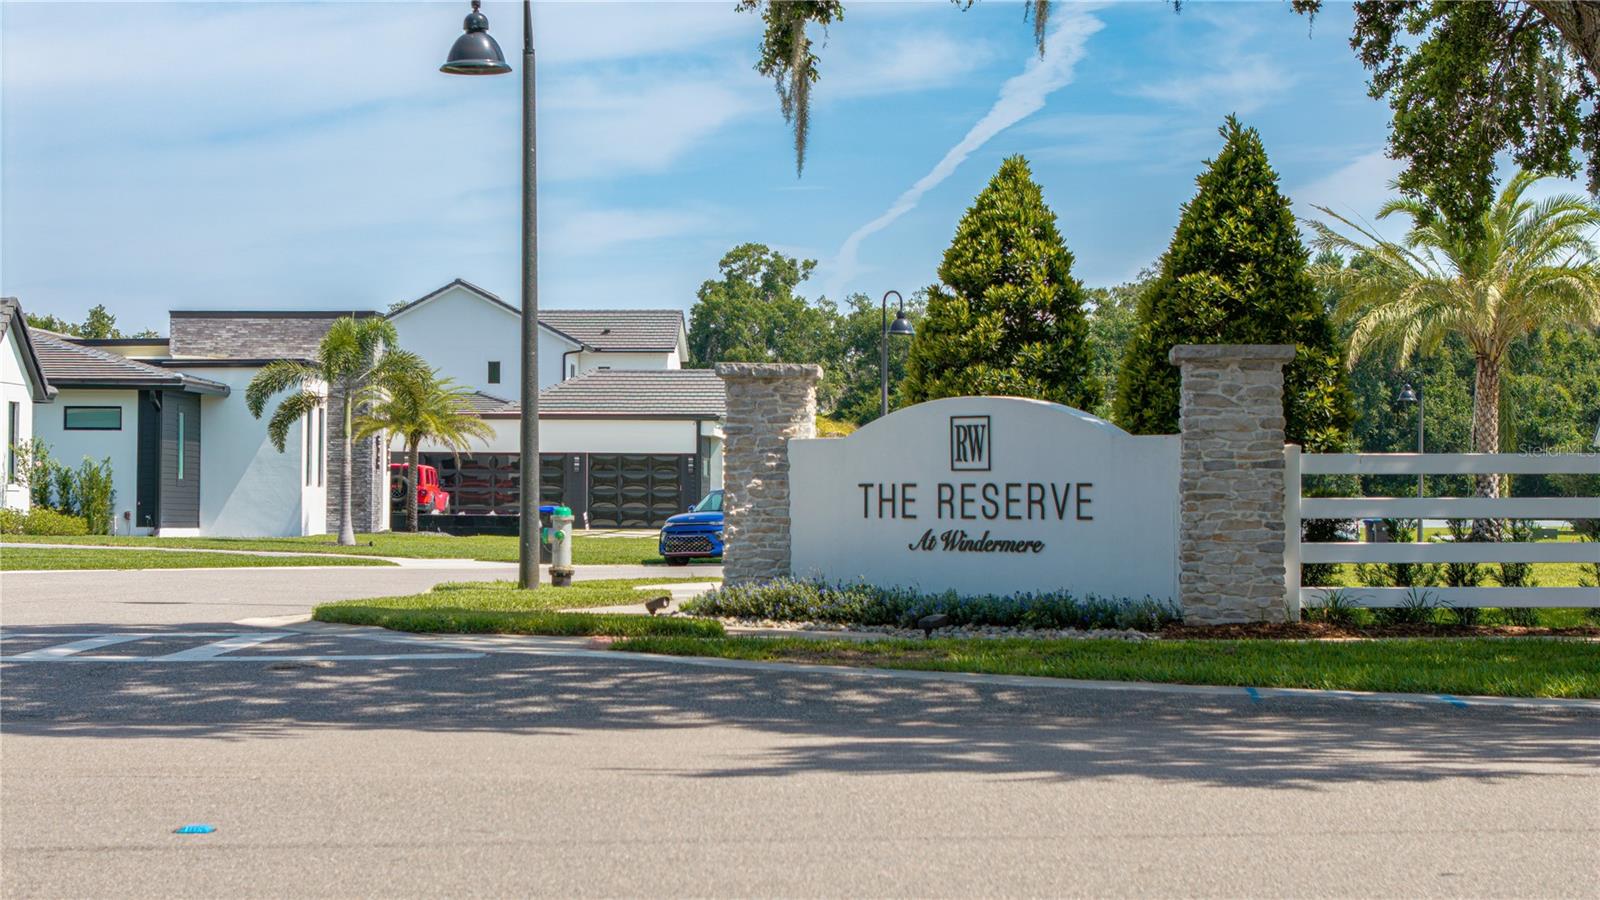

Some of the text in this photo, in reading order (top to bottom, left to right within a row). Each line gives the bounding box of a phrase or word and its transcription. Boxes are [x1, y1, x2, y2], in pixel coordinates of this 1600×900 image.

[955, 424, 986, 463] RW
[858, 483, 1094, 521] THE RESERVE
[908, 528, 1045, 554] At Windermere
